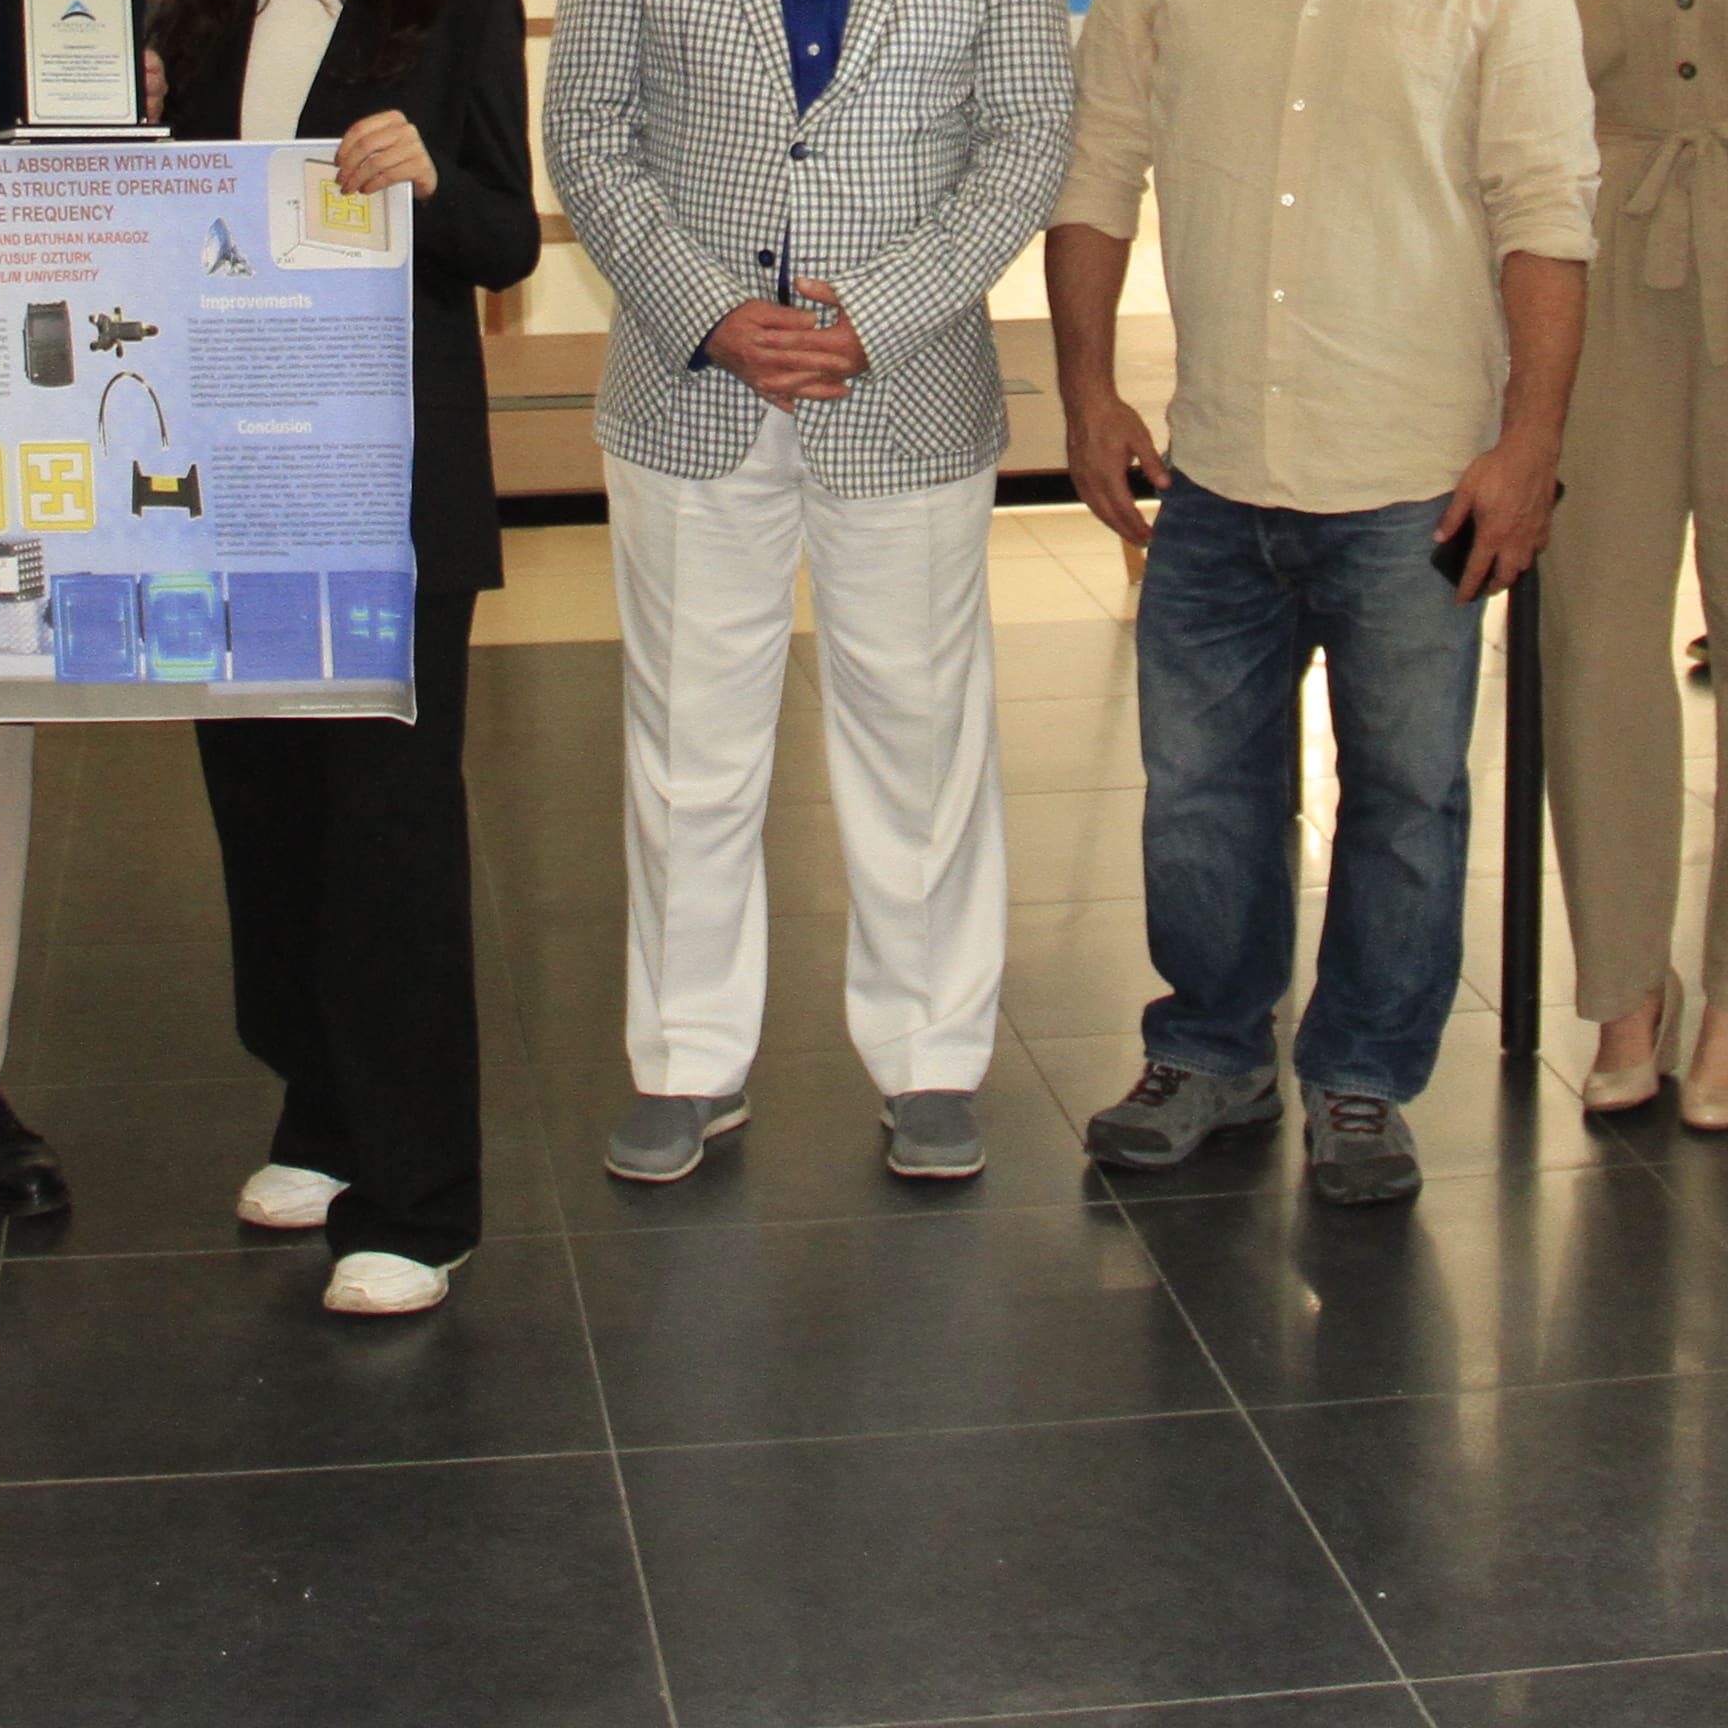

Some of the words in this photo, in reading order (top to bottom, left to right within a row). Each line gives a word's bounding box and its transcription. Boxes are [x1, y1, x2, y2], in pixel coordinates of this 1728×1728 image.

[17, 155, 109, 173] ABSORBER
[115, 155, 156, 171] WITH
[161, 157, 171, 170] A
[177, 154, 232, 169] NOVEL
[11, 181, 111, 197] STRUCTURE
[117, 179, 212, 196] OPERATING
[218, 178, 237, 193] AT
[12, 205, 114, 222] FREQUENCY
[25, 233, 83, 245] BATUHAN
[88, 231, 150, 244] KARAGOZ
[41, 252, 92, 264] OZTURK
[25, 269, 99, 282] UNIVERSITY
[200, 294, 313, 312] Improvements
[238, 419, 312, 434] Conclusion
